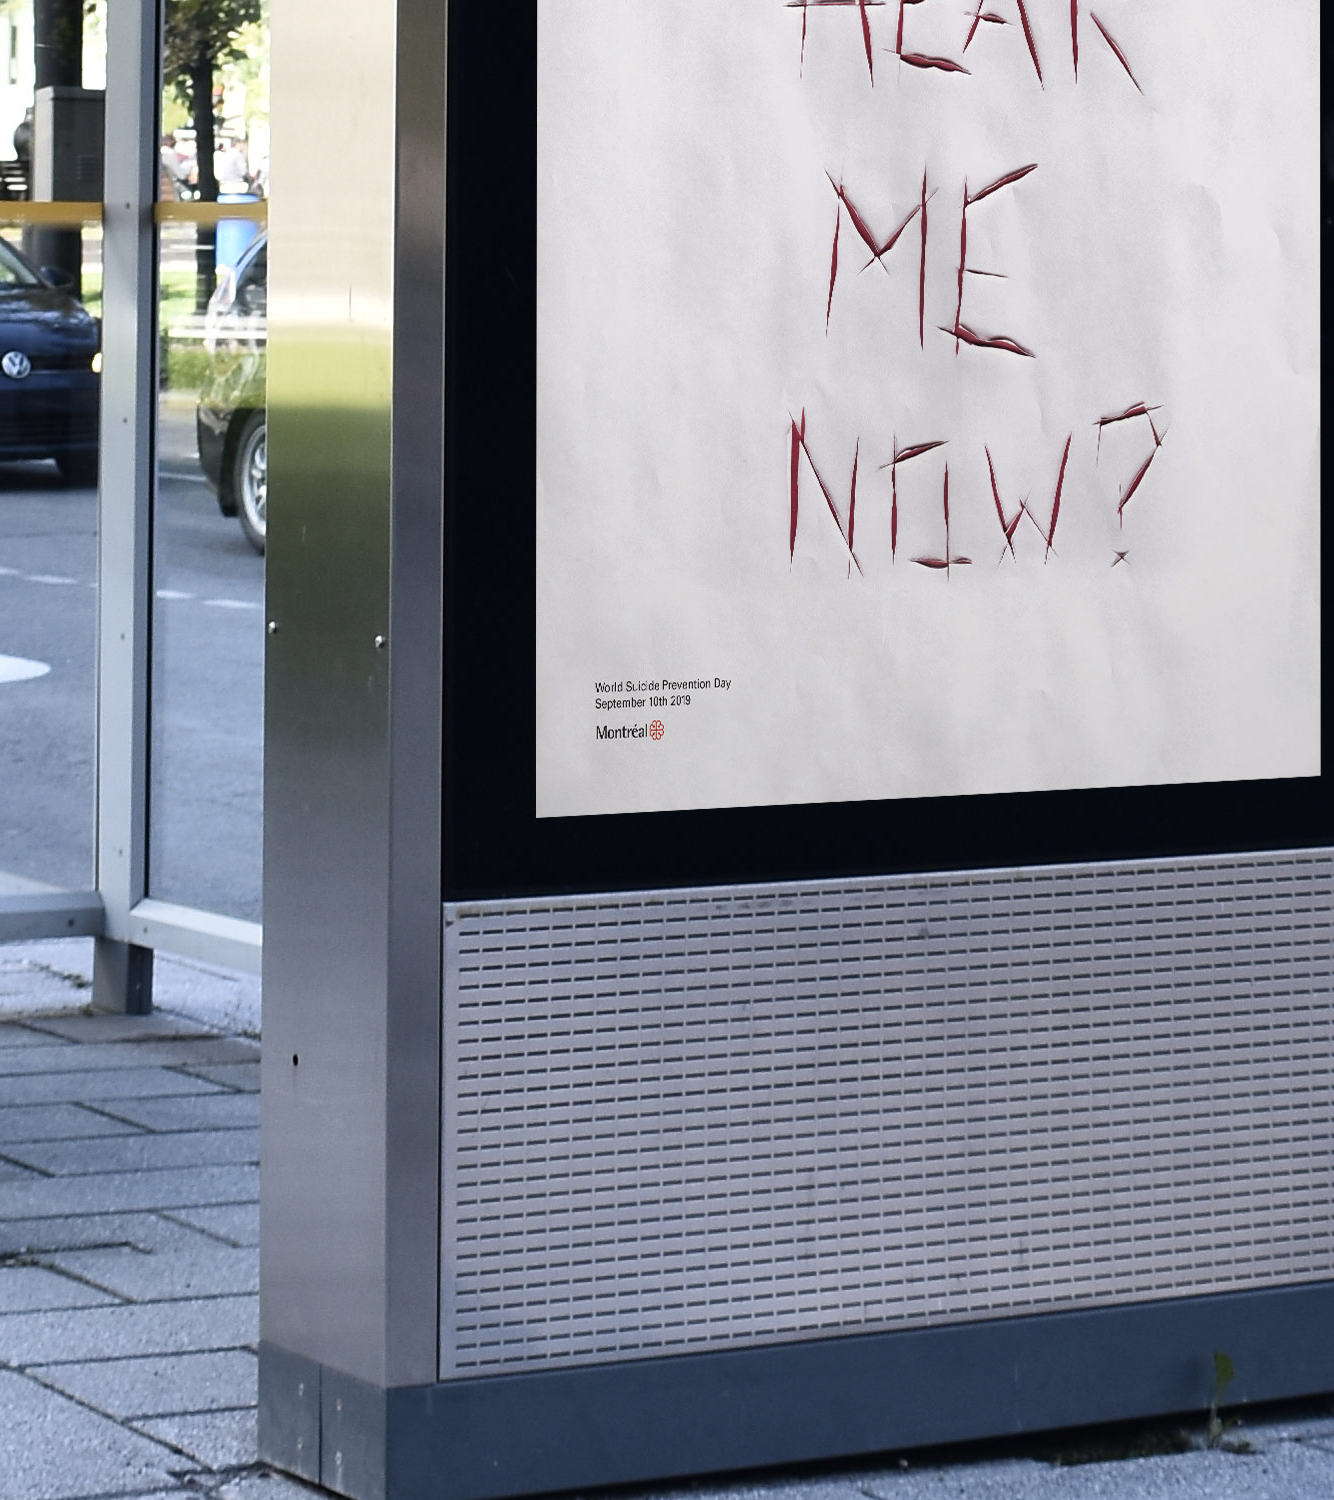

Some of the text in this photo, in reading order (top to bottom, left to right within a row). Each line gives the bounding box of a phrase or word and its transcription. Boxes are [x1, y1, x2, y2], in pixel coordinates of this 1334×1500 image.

[824, 163, 1039, 359] ME
[787, 401, 1169, 581] NOW?
[594, 677, 732, 693] World Suicide Prevention Day
[594, 694, 691, 712] September 10th 2019
[596, 723, 648, 740] Montréal
